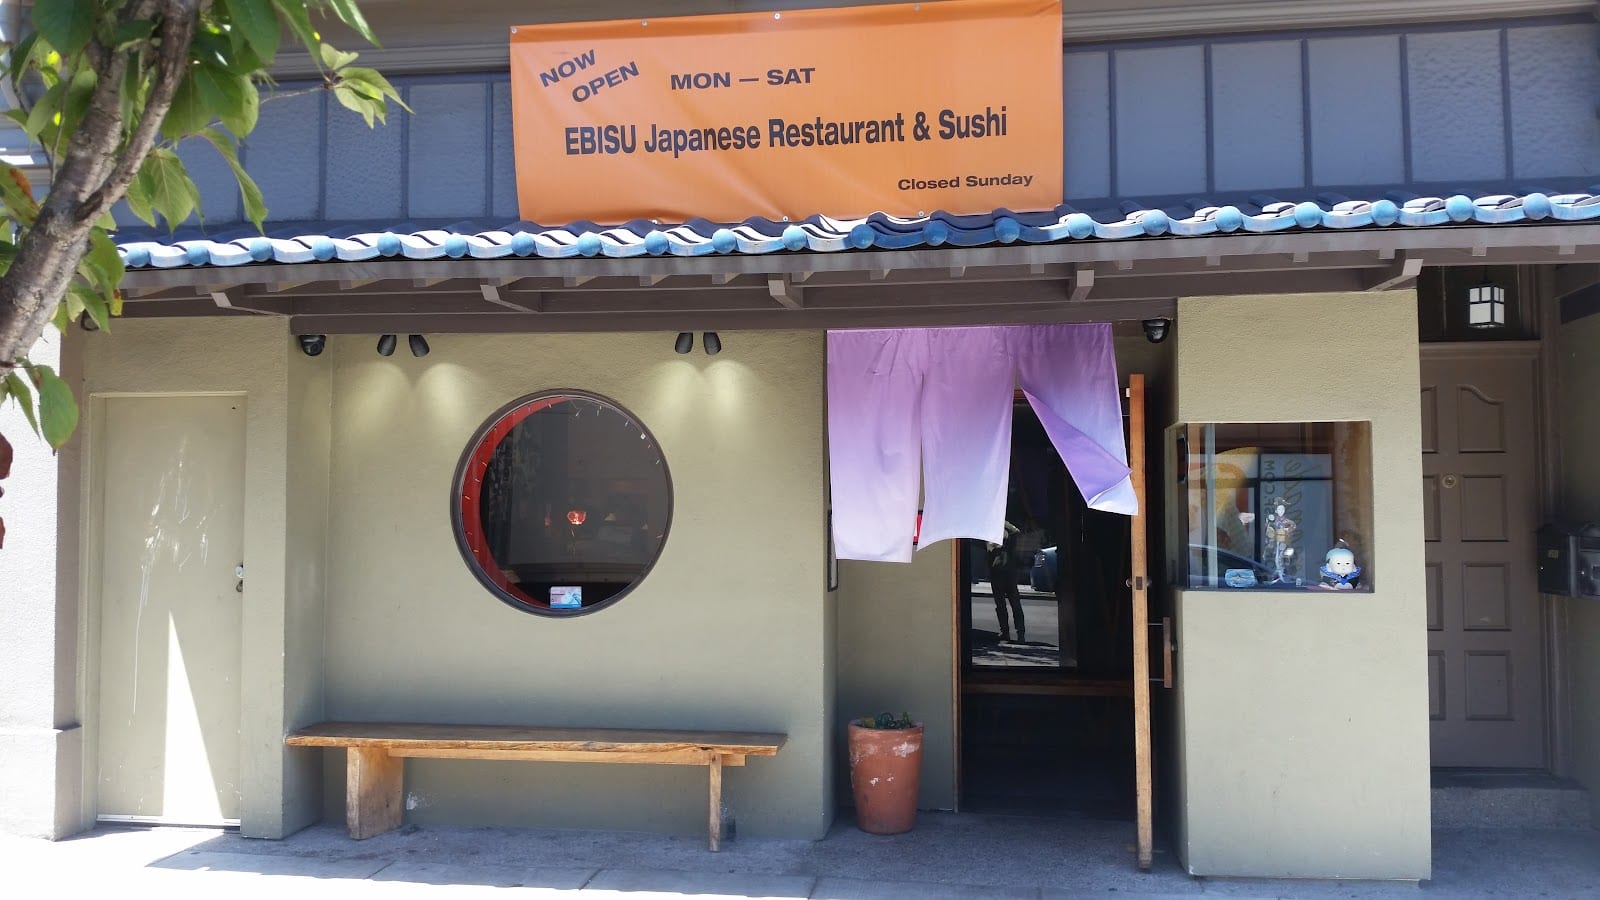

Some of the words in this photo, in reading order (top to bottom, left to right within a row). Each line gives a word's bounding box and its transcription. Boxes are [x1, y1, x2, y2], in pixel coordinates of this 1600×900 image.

[540, 49, 595, 87] NOW
[572, 62, 639, 102] OPEN
[671, 72, 730, 90] MON
[767, 68, 815, 85] SAT
[565, 125, 636, 155] EBISU
[644, 124, 760, 158] Japanese
[769, 113, 904, 147] Restaurant
[913, 112, 931, 141] &
[939, 106, 1006, 139] Sushi
[898, 177, 960, 190] Closed
[966, 174, 1033, 187] Sunday
